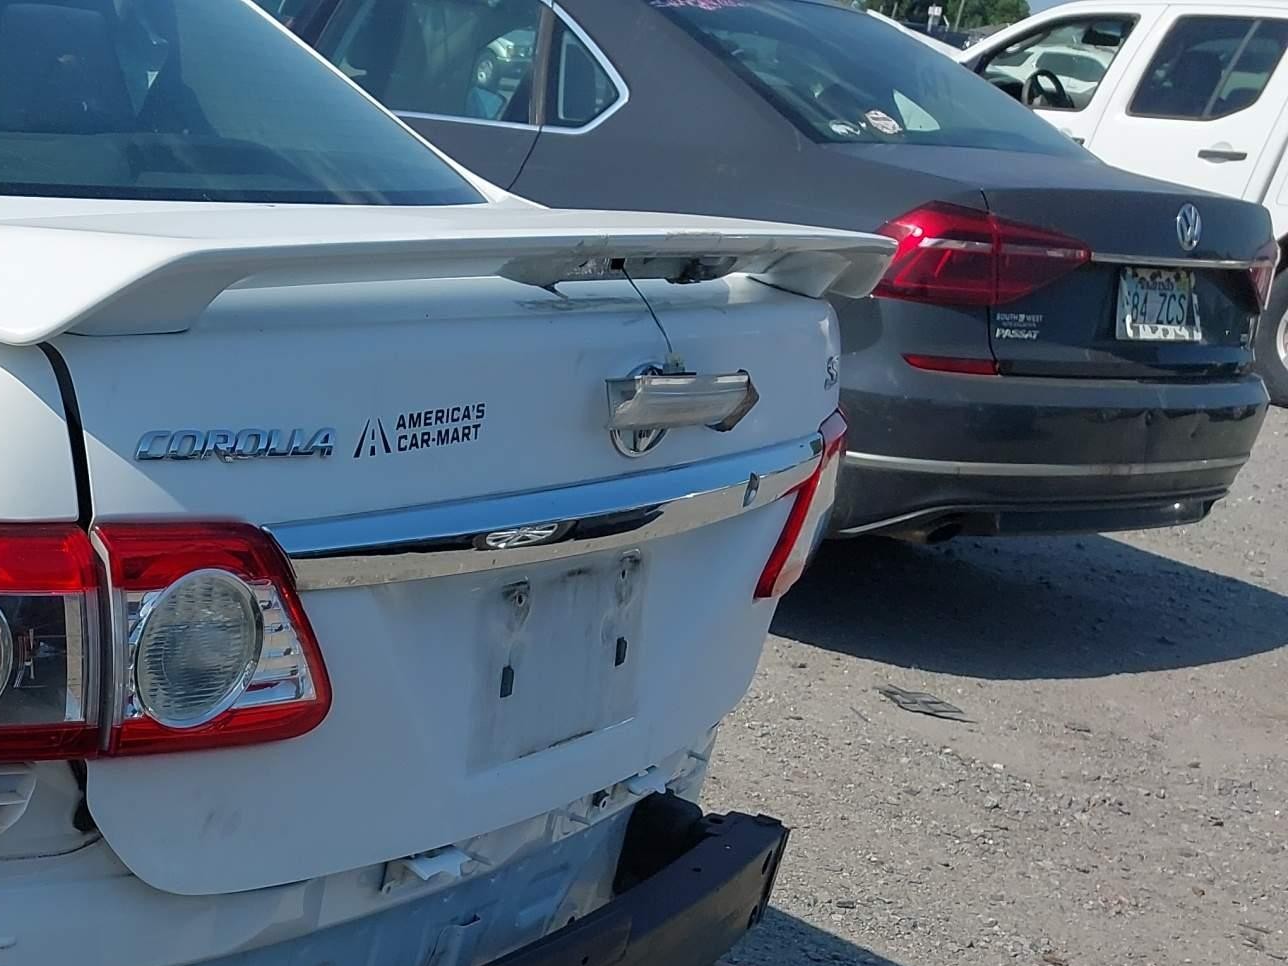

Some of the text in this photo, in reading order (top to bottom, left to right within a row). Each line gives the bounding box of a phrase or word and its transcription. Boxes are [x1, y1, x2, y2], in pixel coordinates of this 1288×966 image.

[1125, 291, 1186, 324] 84 ZCS
[995, 328, 1040, 340] PASSAT
[396, 403, 486, 430] AMERICA'S
[136, 427, 336, 460] COROLLA
[397, 424, 481, 452] CAR-MART
